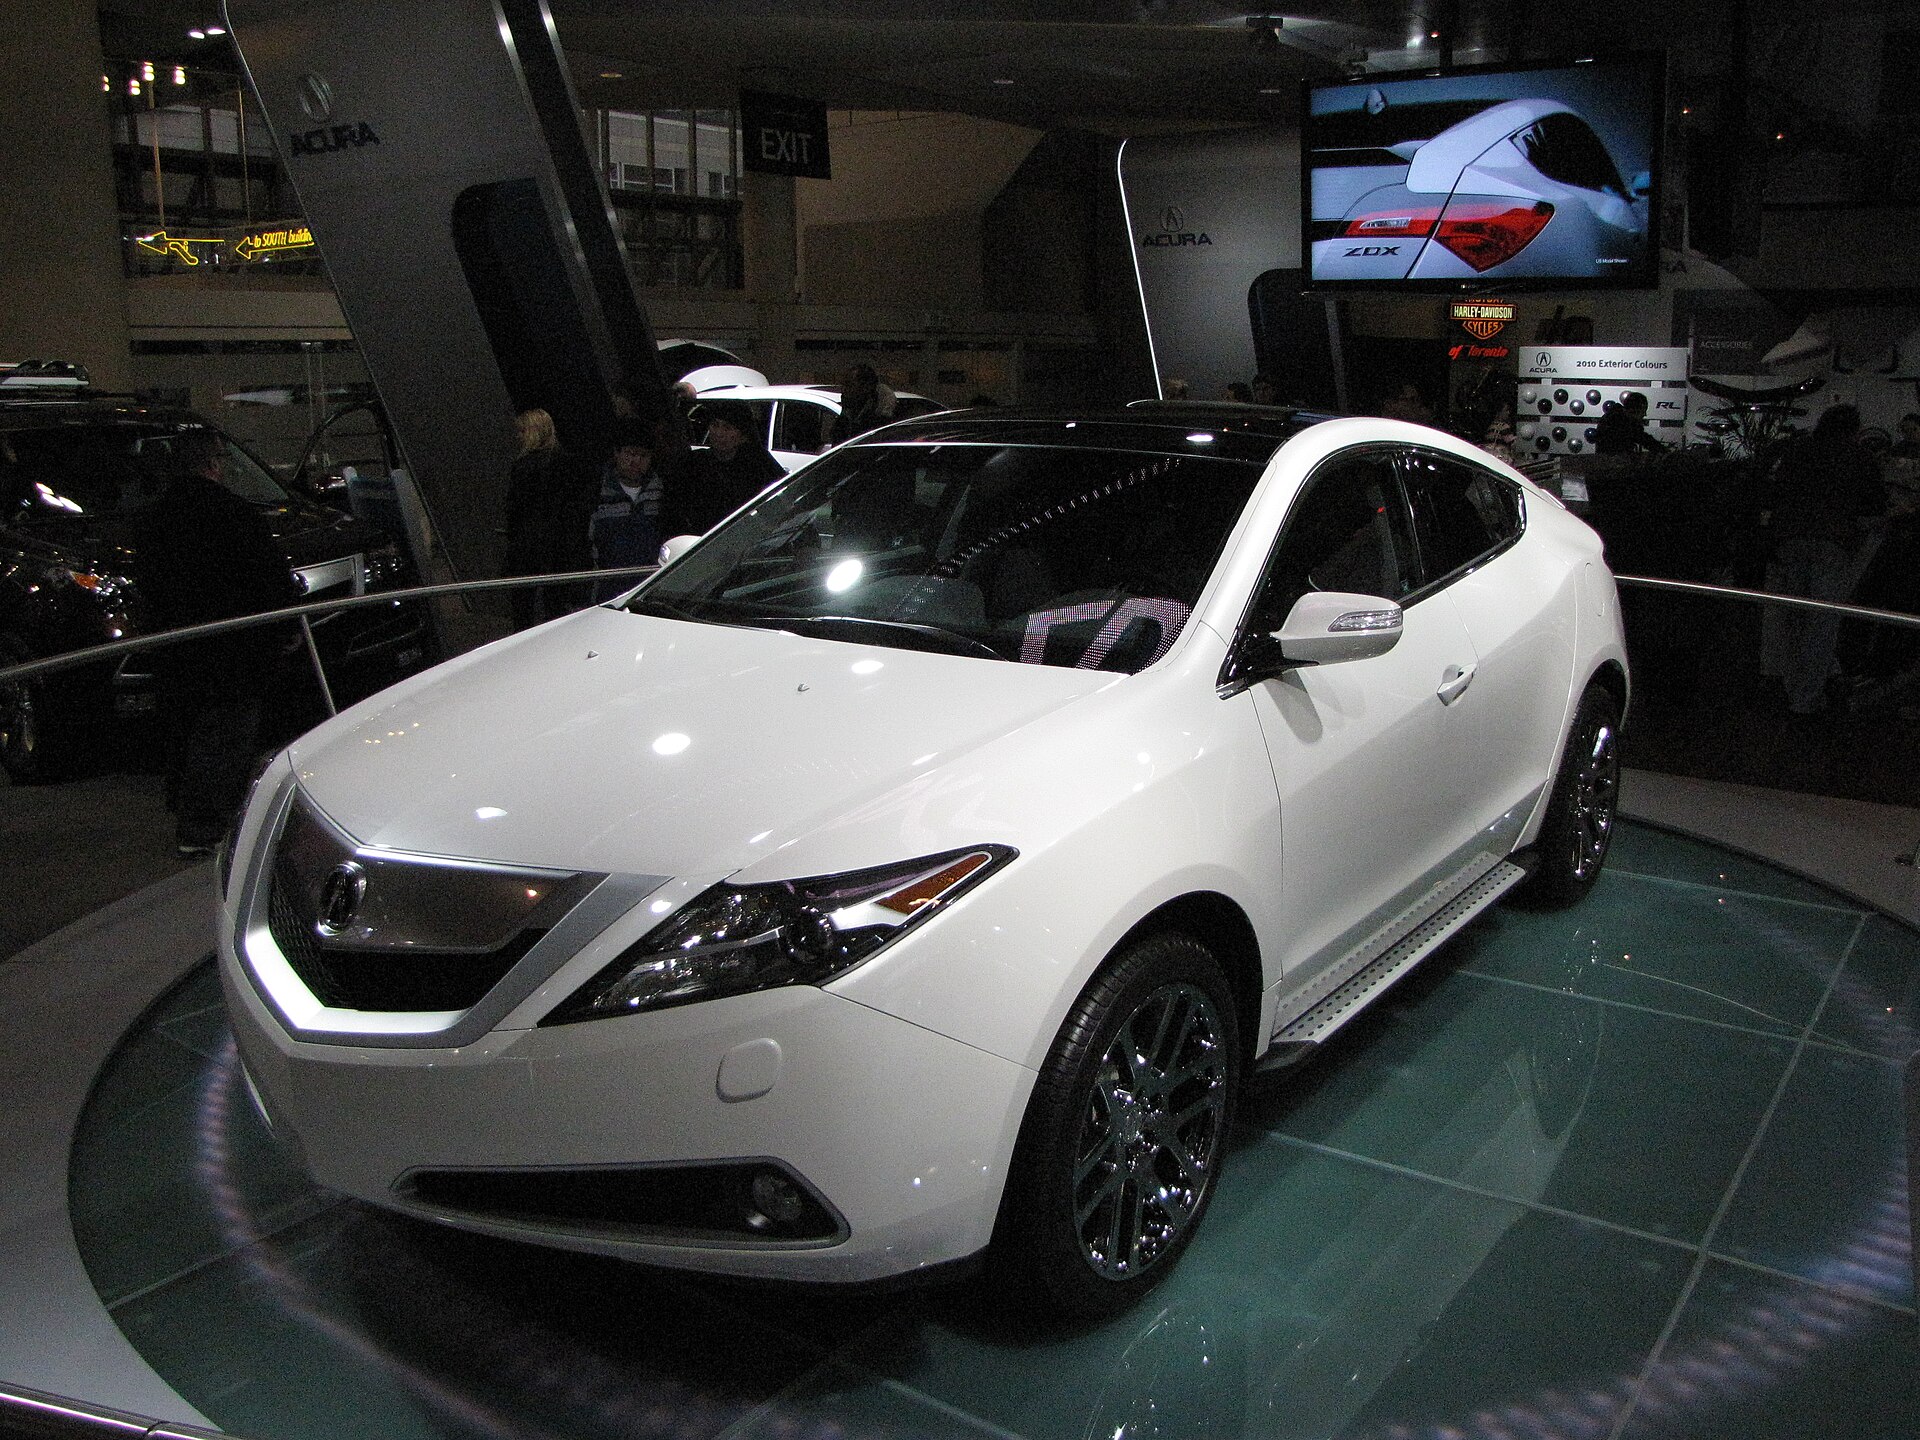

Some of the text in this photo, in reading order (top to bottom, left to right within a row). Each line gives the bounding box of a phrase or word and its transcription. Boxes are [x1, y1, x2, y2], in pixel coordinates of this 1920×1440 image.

[290, 121, 380, 156] ACURA
[761, 127, 813, 164] EXIT
[253, 228, 313, 248] to SOUTH buildin
[1143, 233, 1212, 247] ACURA
[1342, 246, 1400, 257] ZDX
[1453, 305, 1513, 319] HARLEY-DAVIDSON
[1467, 321, 1499, 337] CYCLES
[1447, 345, 1464, 361] of
[1576, 359, 1668, 369] 2010 Exterior Colours
[1655, 401, 1681, 410] RL
